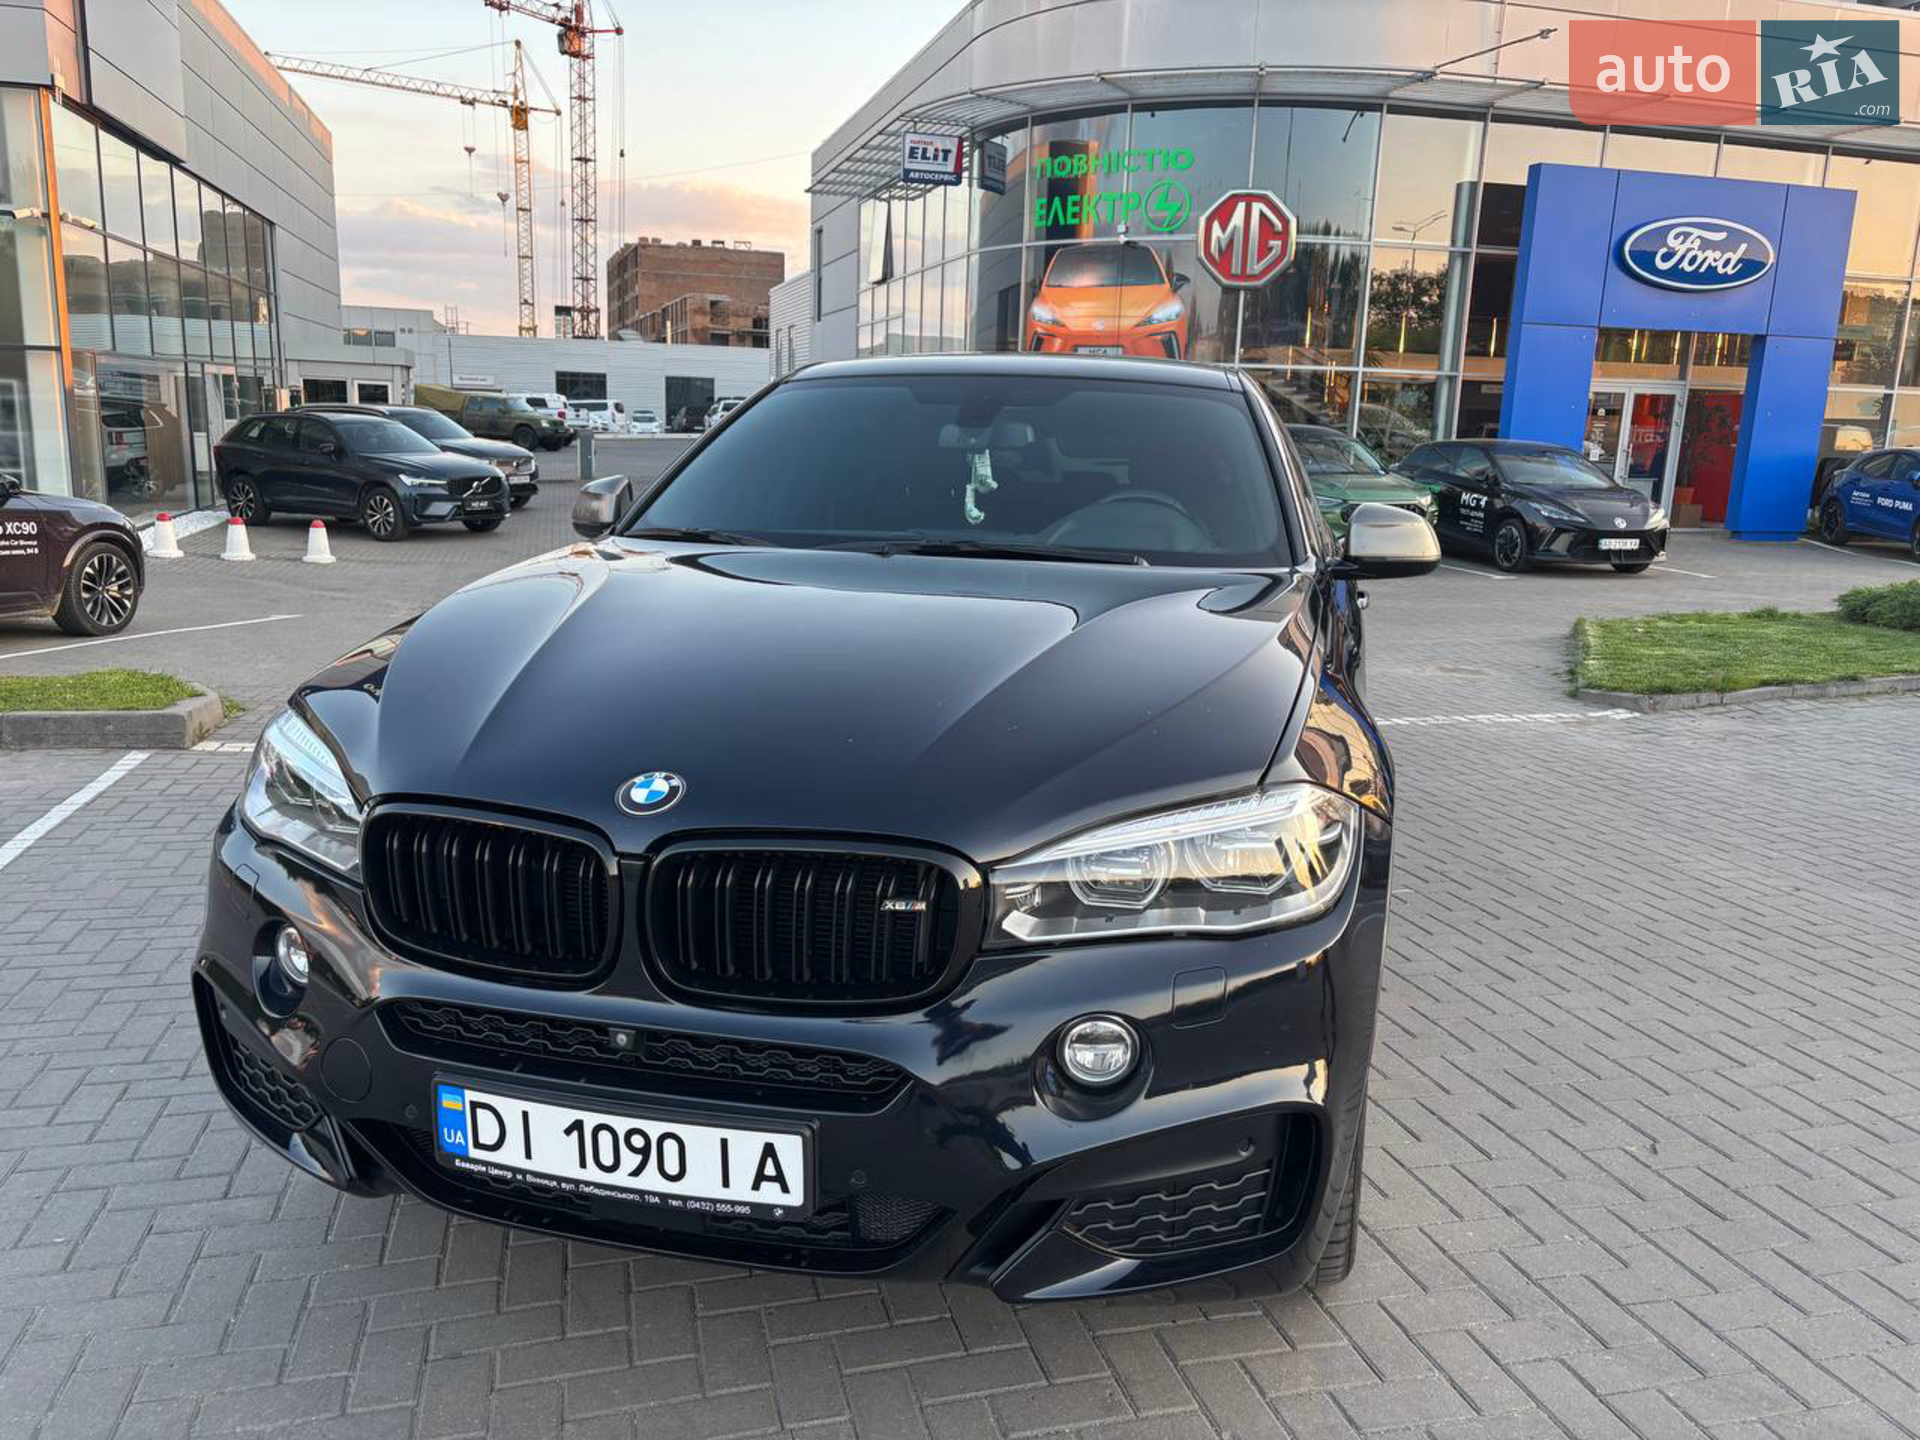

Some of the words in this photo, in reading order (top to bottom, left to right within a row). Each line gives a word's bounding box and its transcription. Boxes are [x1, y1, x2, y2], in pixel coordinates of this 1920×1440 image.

[908, 171, 957, 182] АВТОСЕРВІС
[1034, 146, 1196, 181] ПОВНІСТЮ
[1209, 200, 1283, 277] MG
[1655, 225, 1748, 277] Ford
[1877, 497, 1893, 508] FORD
[1895, 500, 1913, 511] PUMA
[5, 521, 37, 534] XC90
[444, 1127, 466, 1147] UA
[468, 1099, 533, 1161] DI
[563, 1118, 687, 1183] 1090
[719, 1136, 791, 1195] IA
[455, 1158, 487, 1174] Баварія
[487, 1164, 513, 1179] Центр
[561, 1181, 577, 1192] вул.
[668, 1198, 684, 1208] тел.
[686, 1199, 715, 1213] (0432)
[715, 1203, 751, 1216] 555-995
